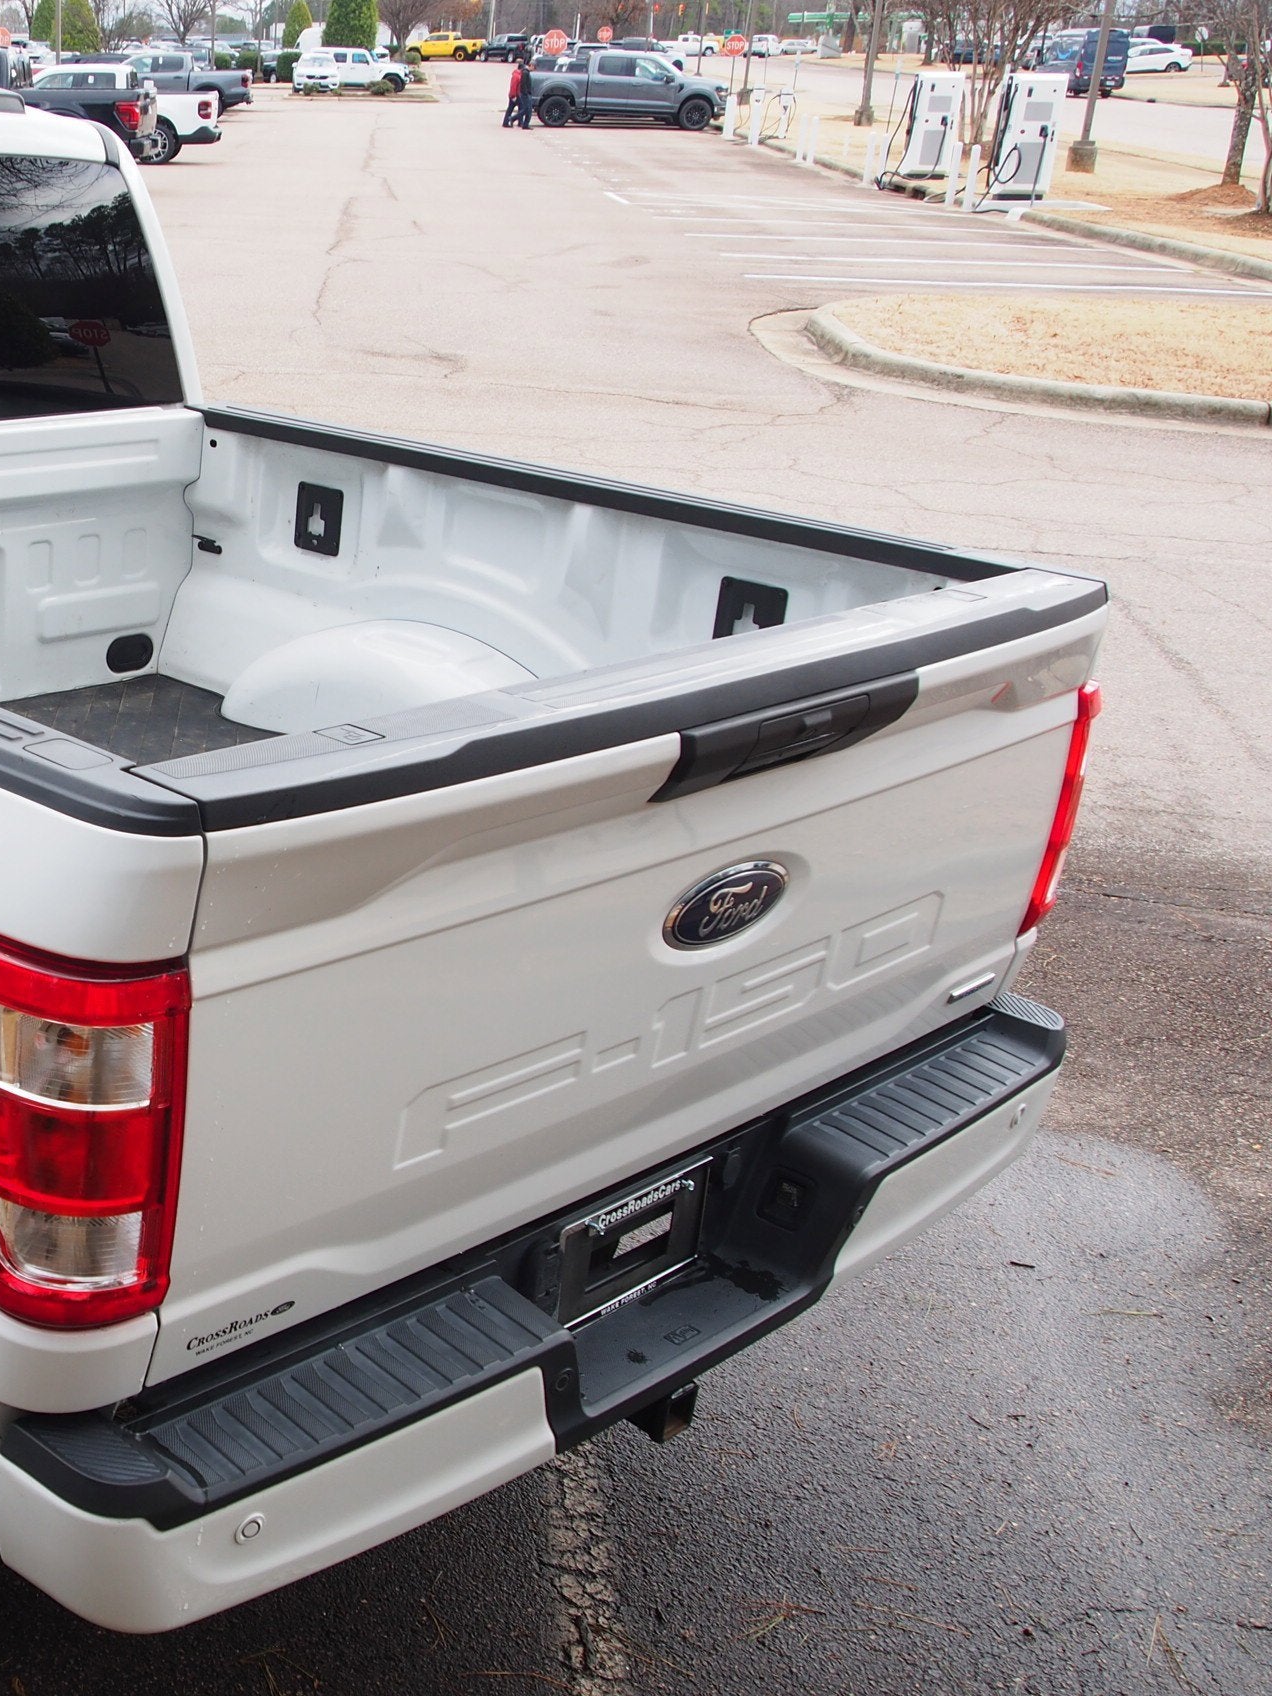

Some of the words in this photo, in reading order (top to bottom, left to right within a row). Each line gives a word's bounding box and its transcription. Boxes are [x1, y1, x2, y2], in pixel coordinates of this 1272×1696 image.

[544, 38, 566, 49] STOP
[726, 41, 745, 50] STOP
[392, 890, 945, 1171] F-150
[600, 1301, 620, 1316] WAKE
[195, 1344, 215, 1356] WAKE
